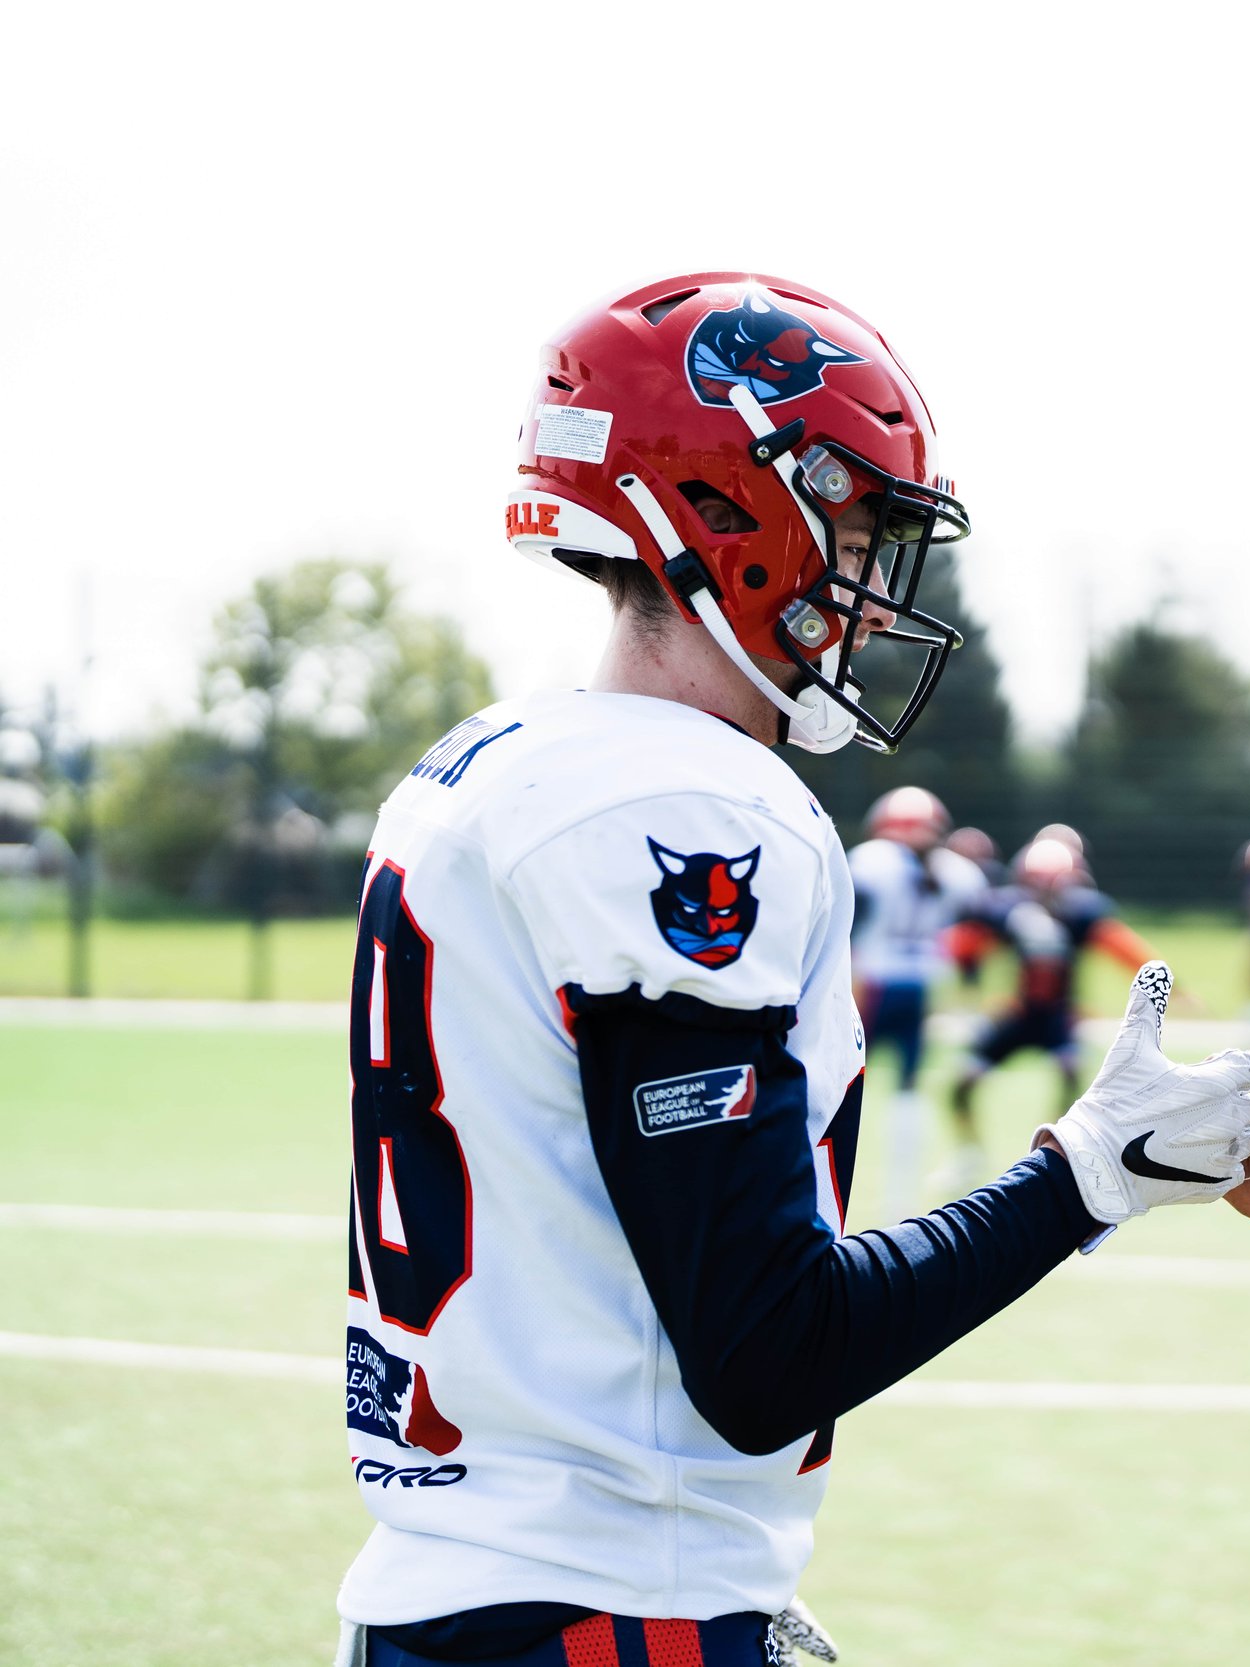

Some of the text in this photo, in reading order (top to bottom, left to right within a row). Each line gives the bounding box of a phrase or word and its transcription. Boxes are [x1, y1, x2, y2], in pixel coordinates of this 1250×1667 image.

[560, 408, 585, 417] WARNING
[348, 850, 473, 1337] 8
[642, 1080, 707, 1103] EUROPEAN
[645, 1096, 691, 1115] LEAGUE
[647, 1105, 709, 1127] FOOTBALL
[347, 1341, 387, 1383] EUROPEAN
[346, 1392, 392, 1432] OOTBALL
[353, 1457, 468, 1490] PRO
